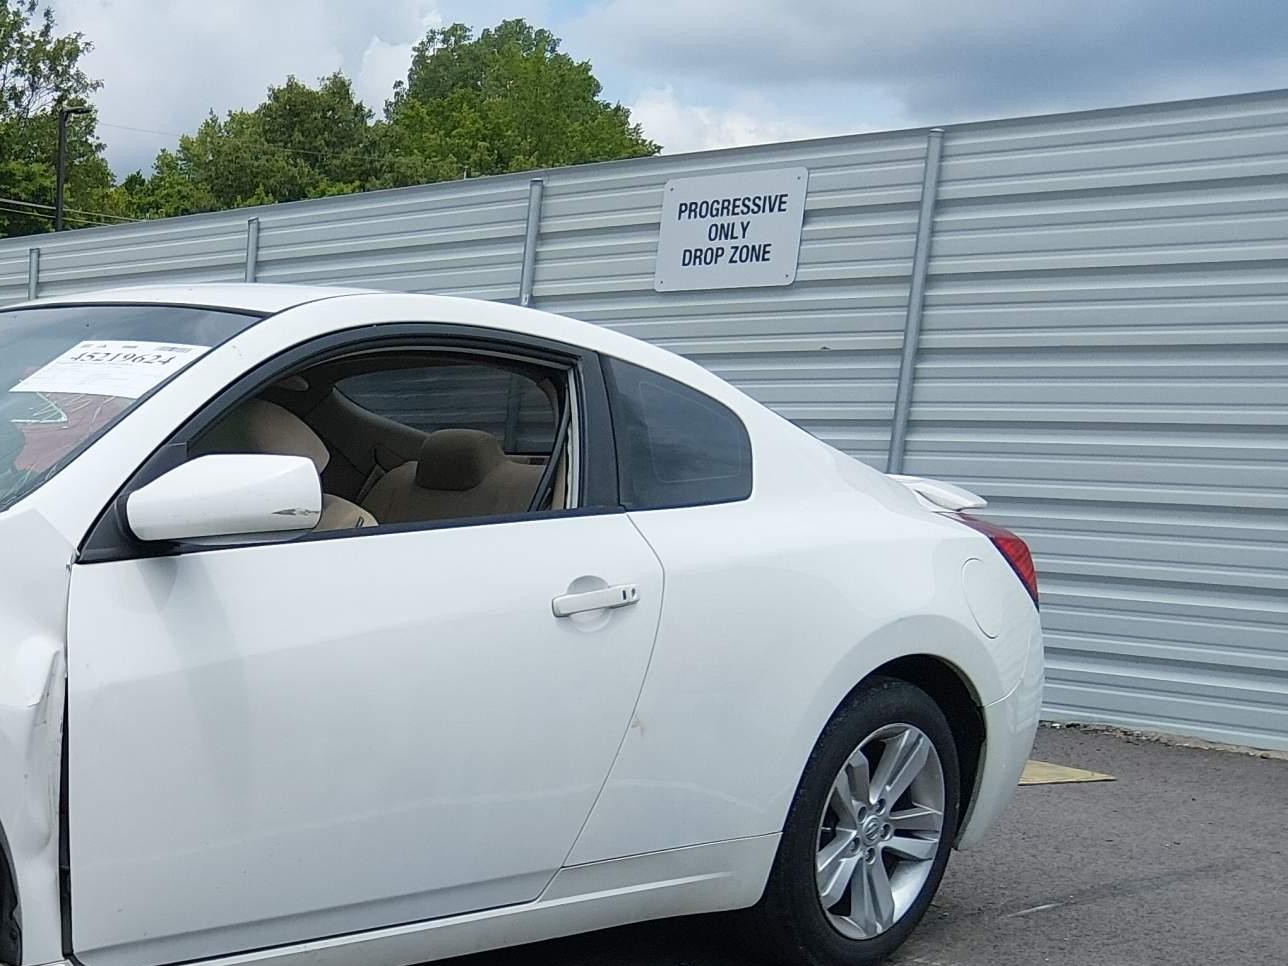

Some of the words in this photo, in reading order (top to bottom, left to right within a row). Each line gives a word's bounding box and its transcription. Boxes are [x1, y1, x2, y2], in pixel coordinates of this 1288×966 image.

[678, 194, 788, 220] PROGRESSIVE
[708, 221, 751, 241] ONLY
[682, 247, 725, 267] DROP
[728, 244, 772, 264] ZONE
[70, 351, 176, 365] 45219624
